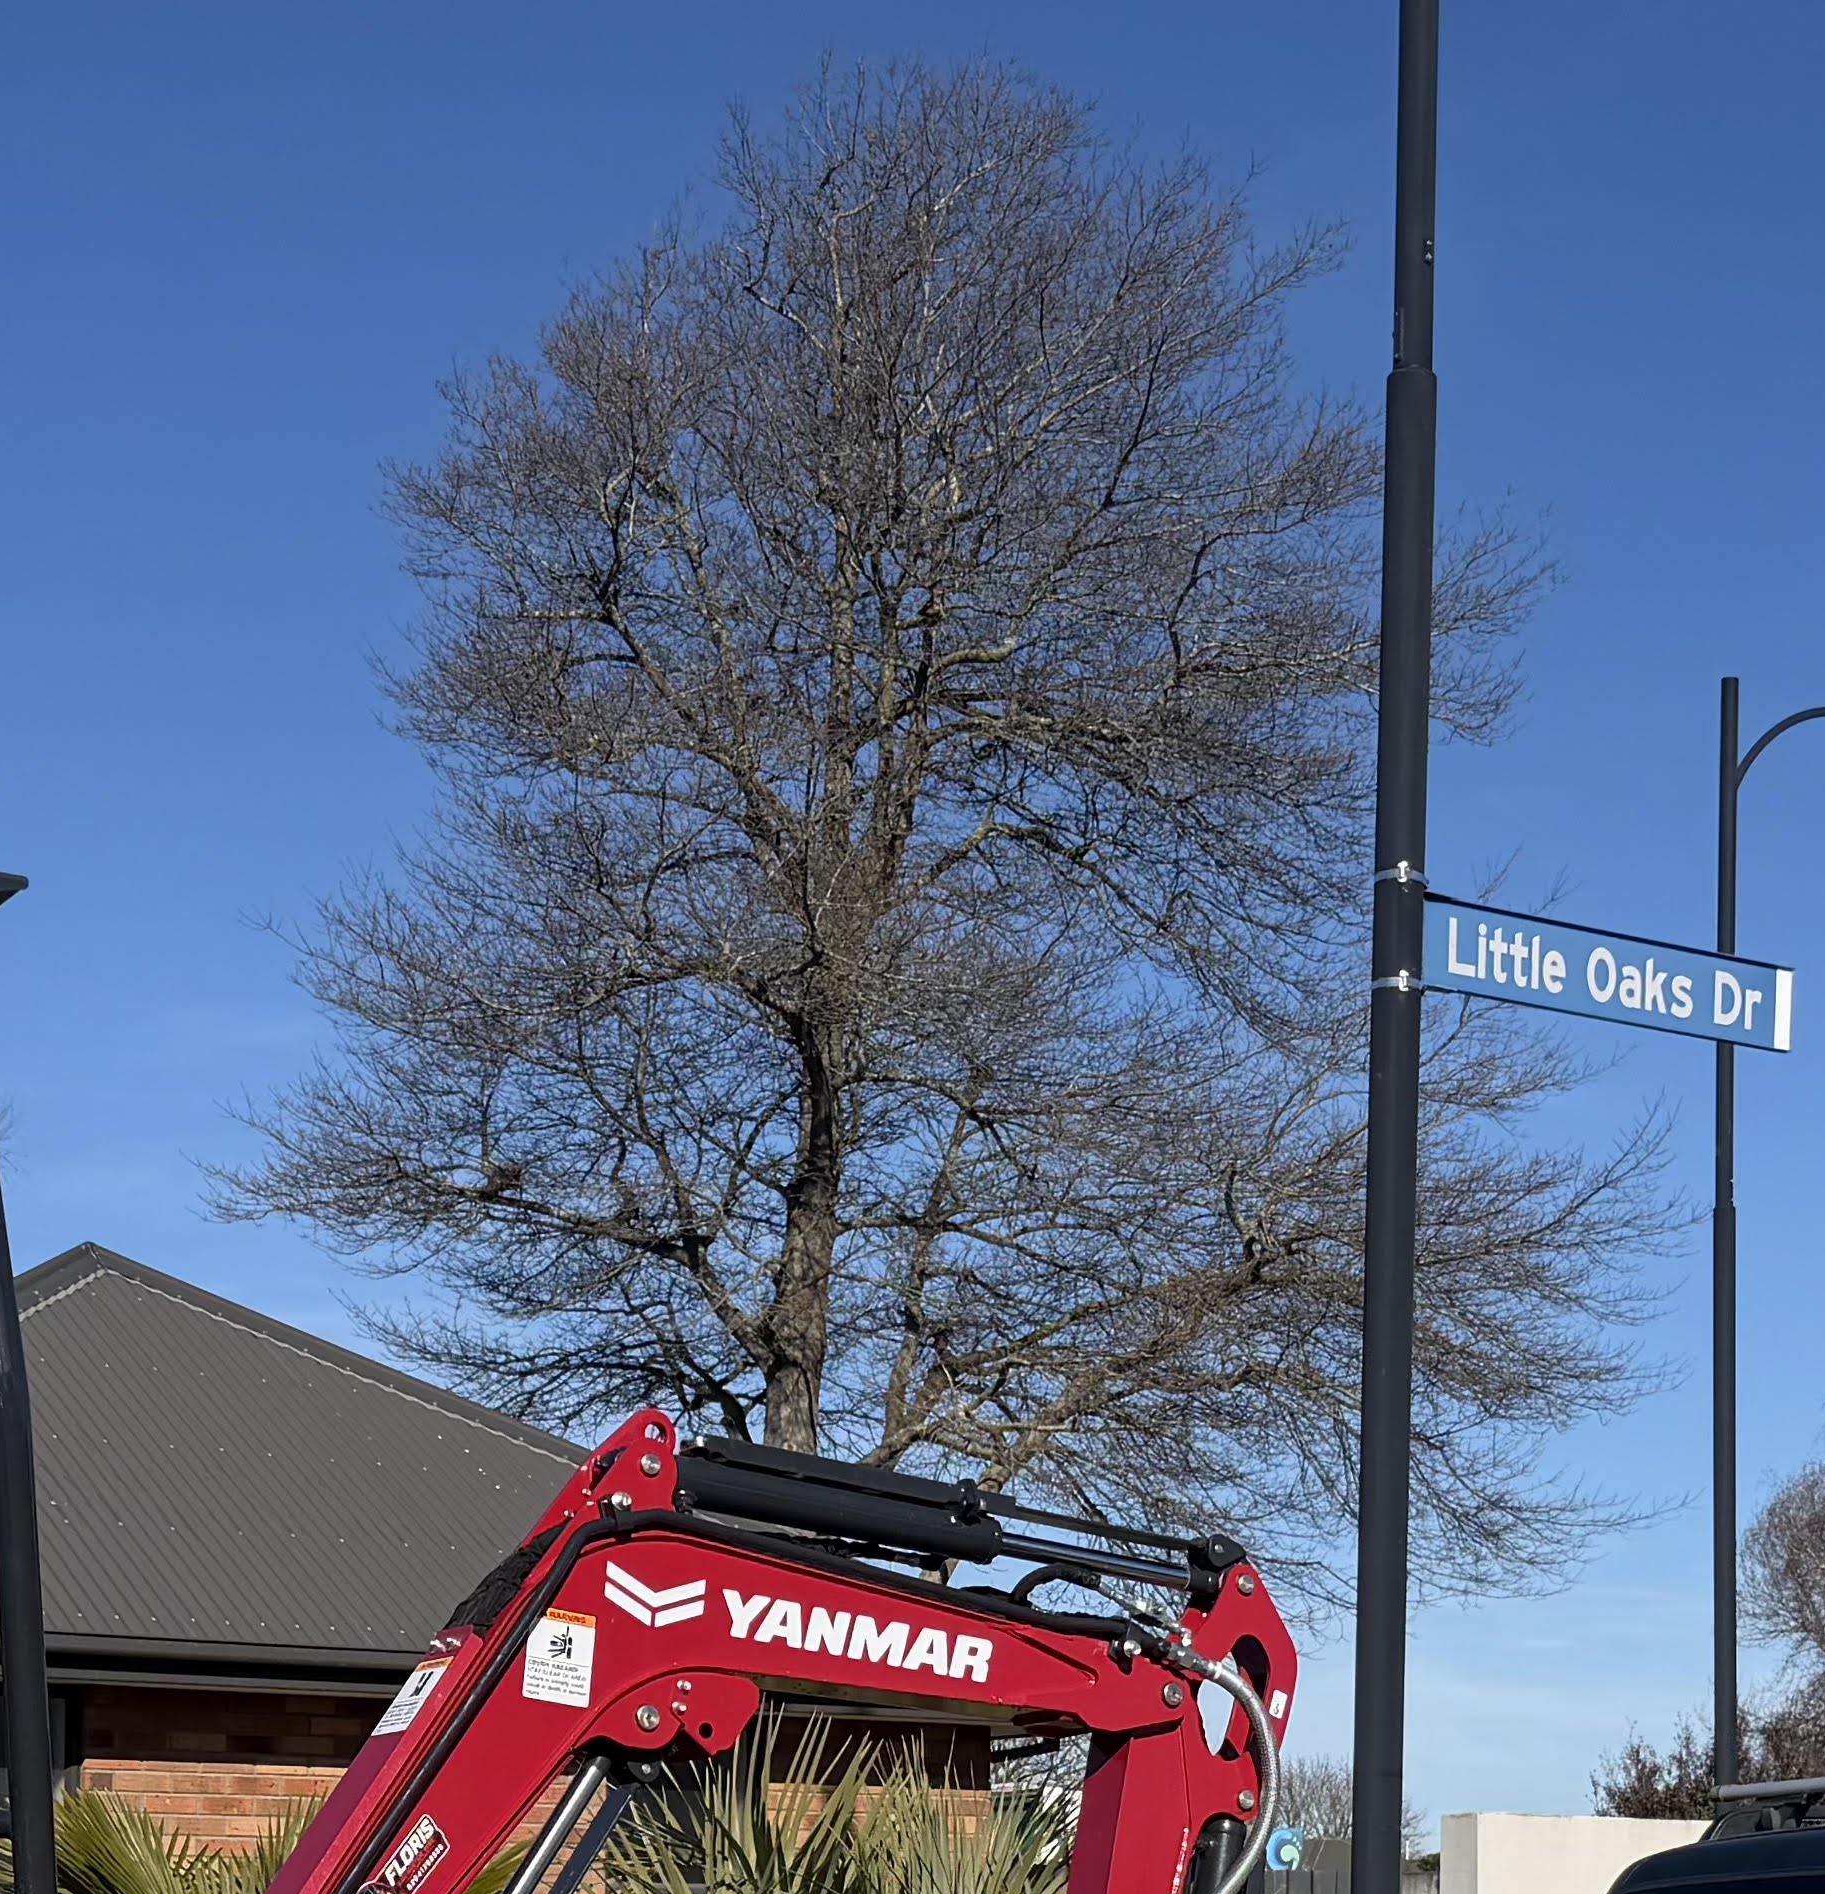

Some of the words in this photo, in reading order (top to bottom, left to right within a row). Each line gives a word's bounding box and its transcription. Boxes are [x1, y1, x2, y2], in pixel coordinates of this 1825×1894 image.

[1447, 916, 1567, 995] Little
[1586, 946, 1695, 1020] Oaks
[1713, 969, 1763, 1031] Dr
[722, 1588, 994, 1684] YANMAR
[384, 1818, 435, 1888] FLORIS
